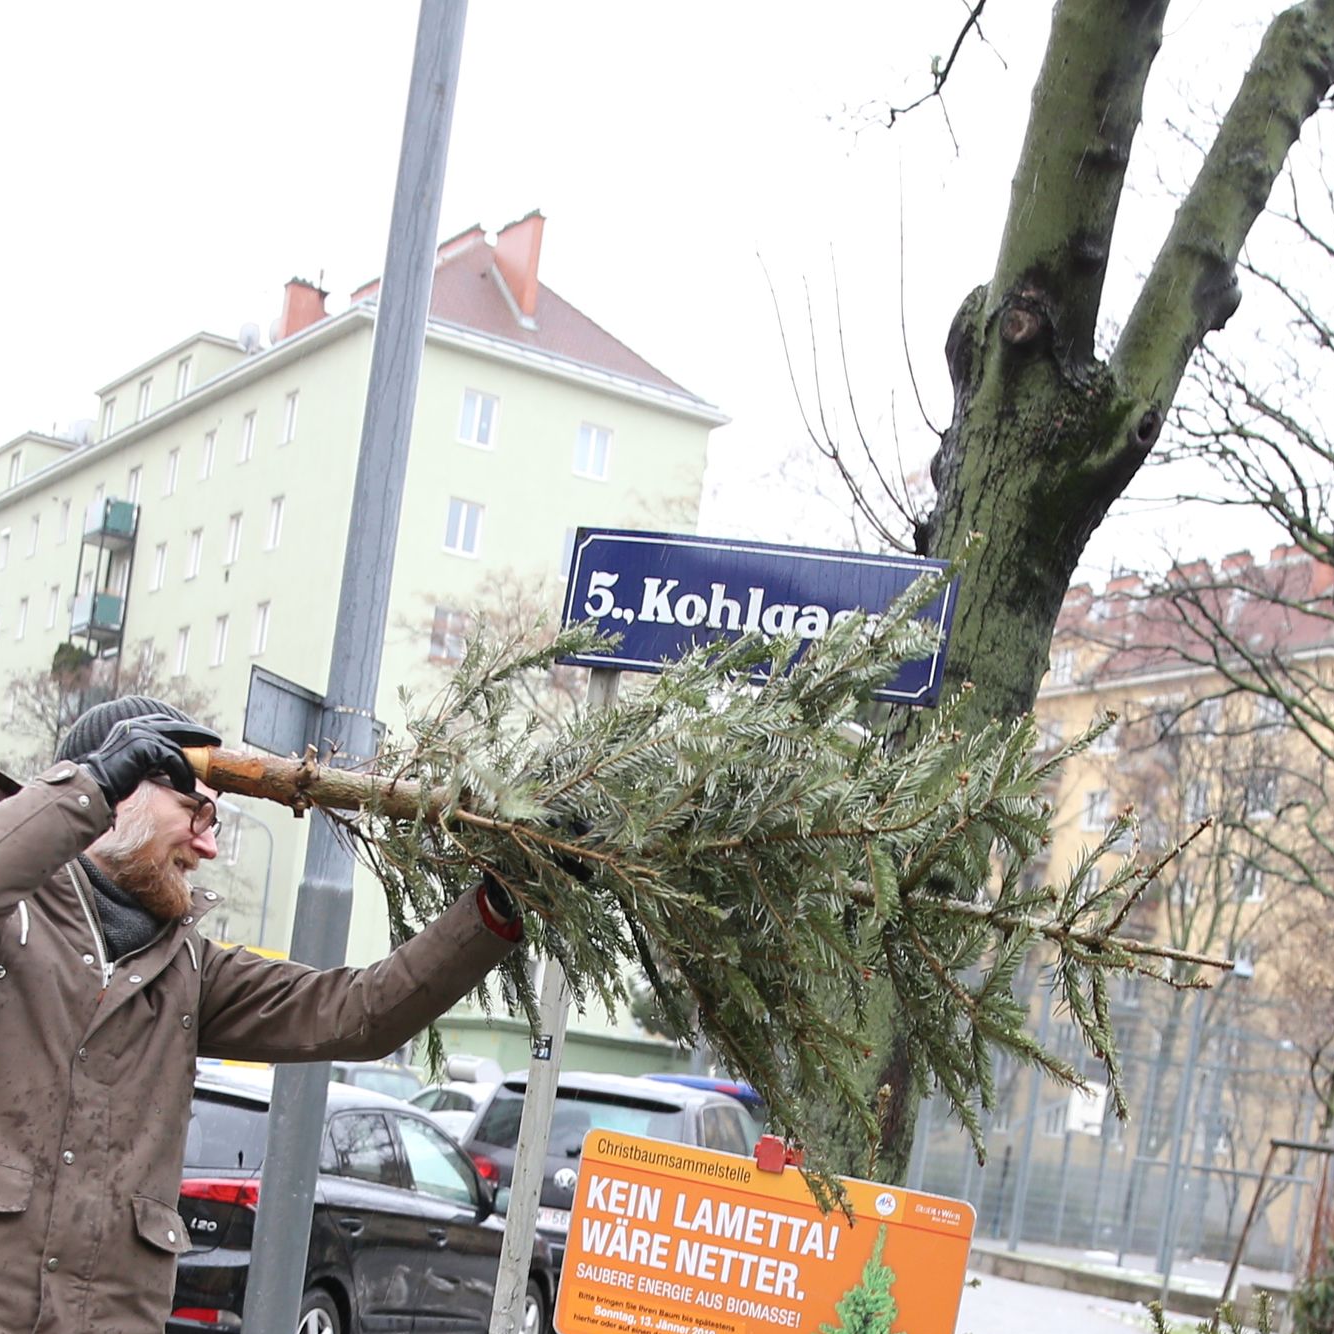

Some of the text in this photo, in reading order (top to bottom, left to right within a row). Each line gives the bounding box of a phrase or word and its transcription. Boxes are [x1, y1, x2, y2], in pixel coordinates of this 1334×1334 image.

[597, 1138, 751, 1183] Christbaumsammelstelle
[586, 1175, 840, 1261] KEIN LAMETTA!
[582, 1217, 805, 1301] WÄRE NETTER.
[576, 1262, 801, 1329] SAUBERE ENERGIE AUS BIOMASSE!
[579, 1291, 595, 1301] Bitte
[597, 1296, 624, 1308] bringen
[626, 1302, 637, 1310] Sie
[659, 1308, 680, 1320] Baum
[681, 1314, 693, 1322] bis
[573, 1313, 599, 1324] hierher
[600, 1320, 617, 1328] oder
[594, 1304, 637, 1326] Sonntag,
[640, 1315, 653, 1327] 13.
[655, 1318, 690, 1334] Jänner
